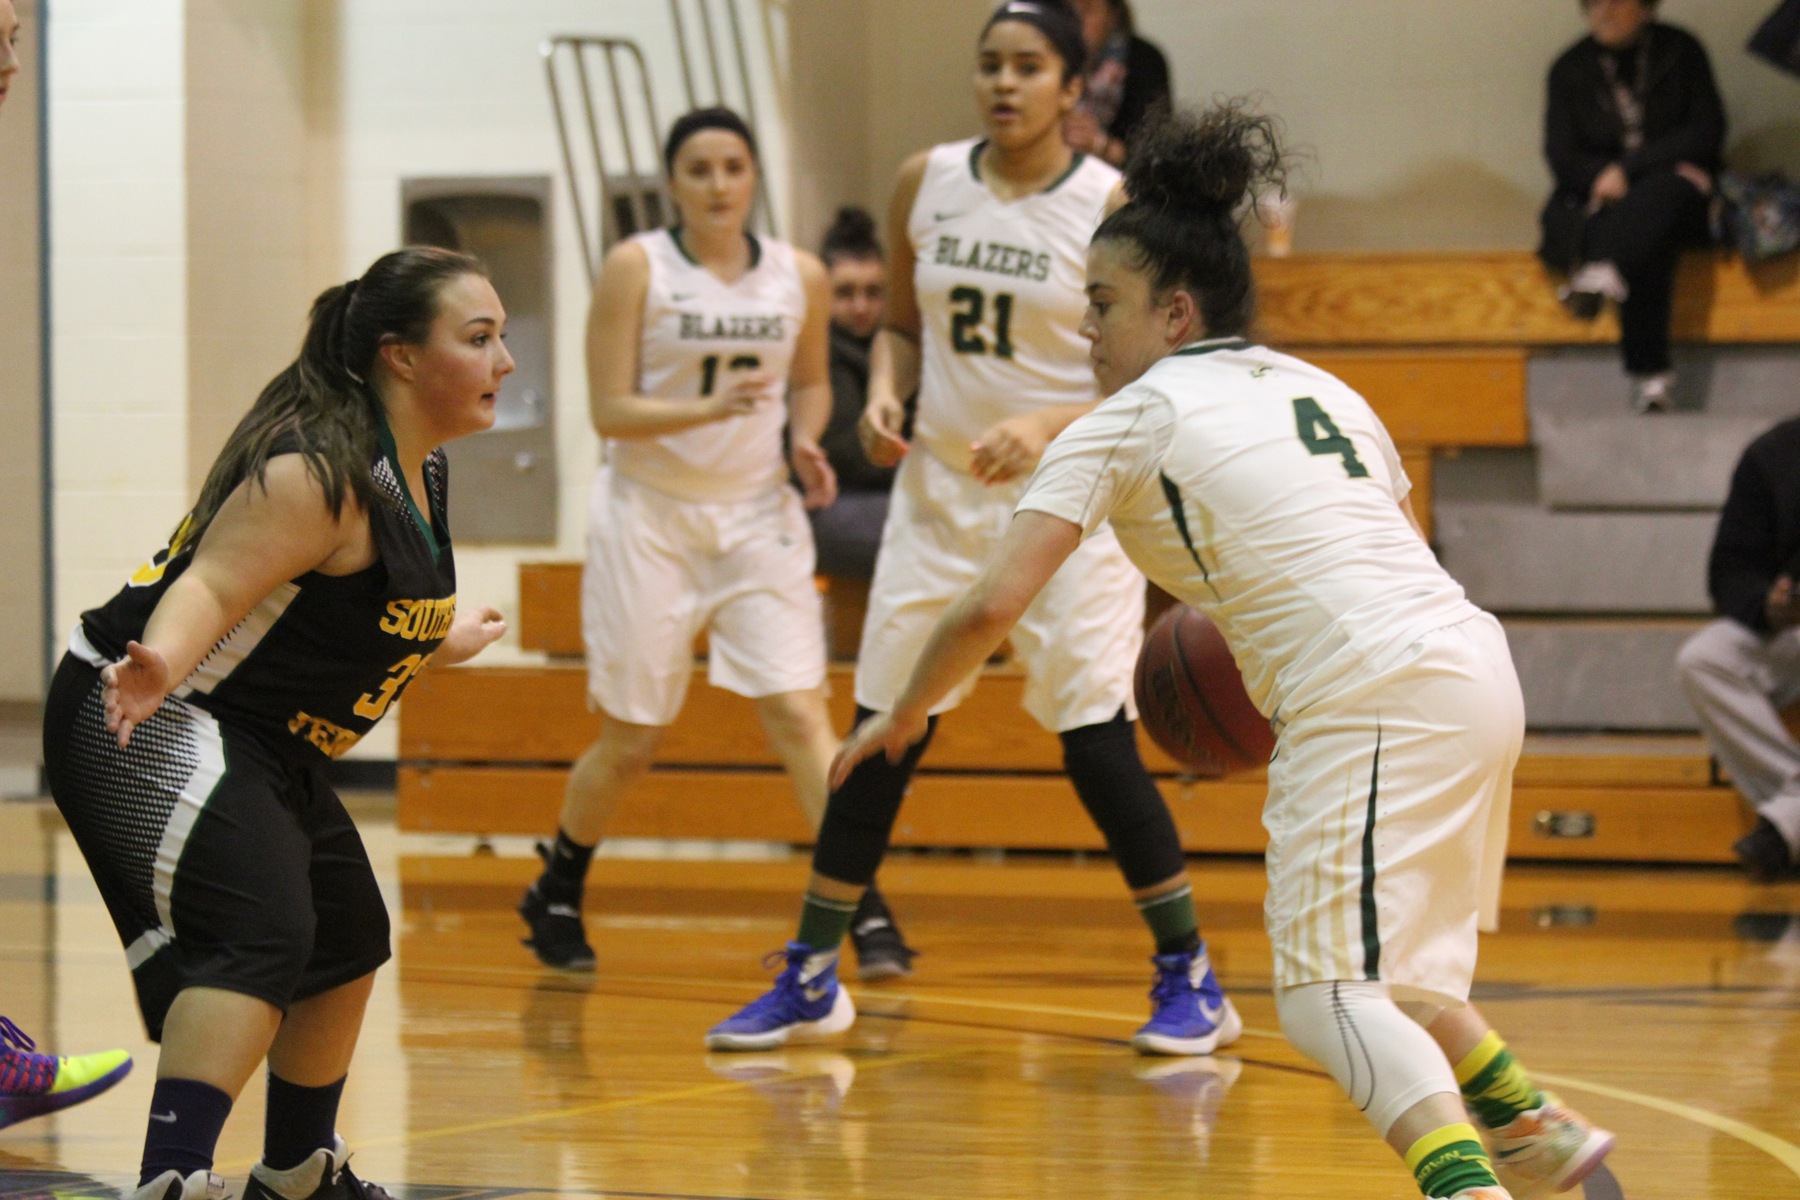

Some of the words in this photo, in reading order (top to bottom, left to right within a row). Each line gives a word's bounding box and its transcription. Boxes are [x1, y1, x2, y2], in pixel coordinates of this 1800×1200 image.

[935, 234, 1050, 281] BLAZERS
[680, 312, 783, 340] BLAZERS
[950, 285, 1014, 358] 21
[1292, 397, 1370, 478] 4
